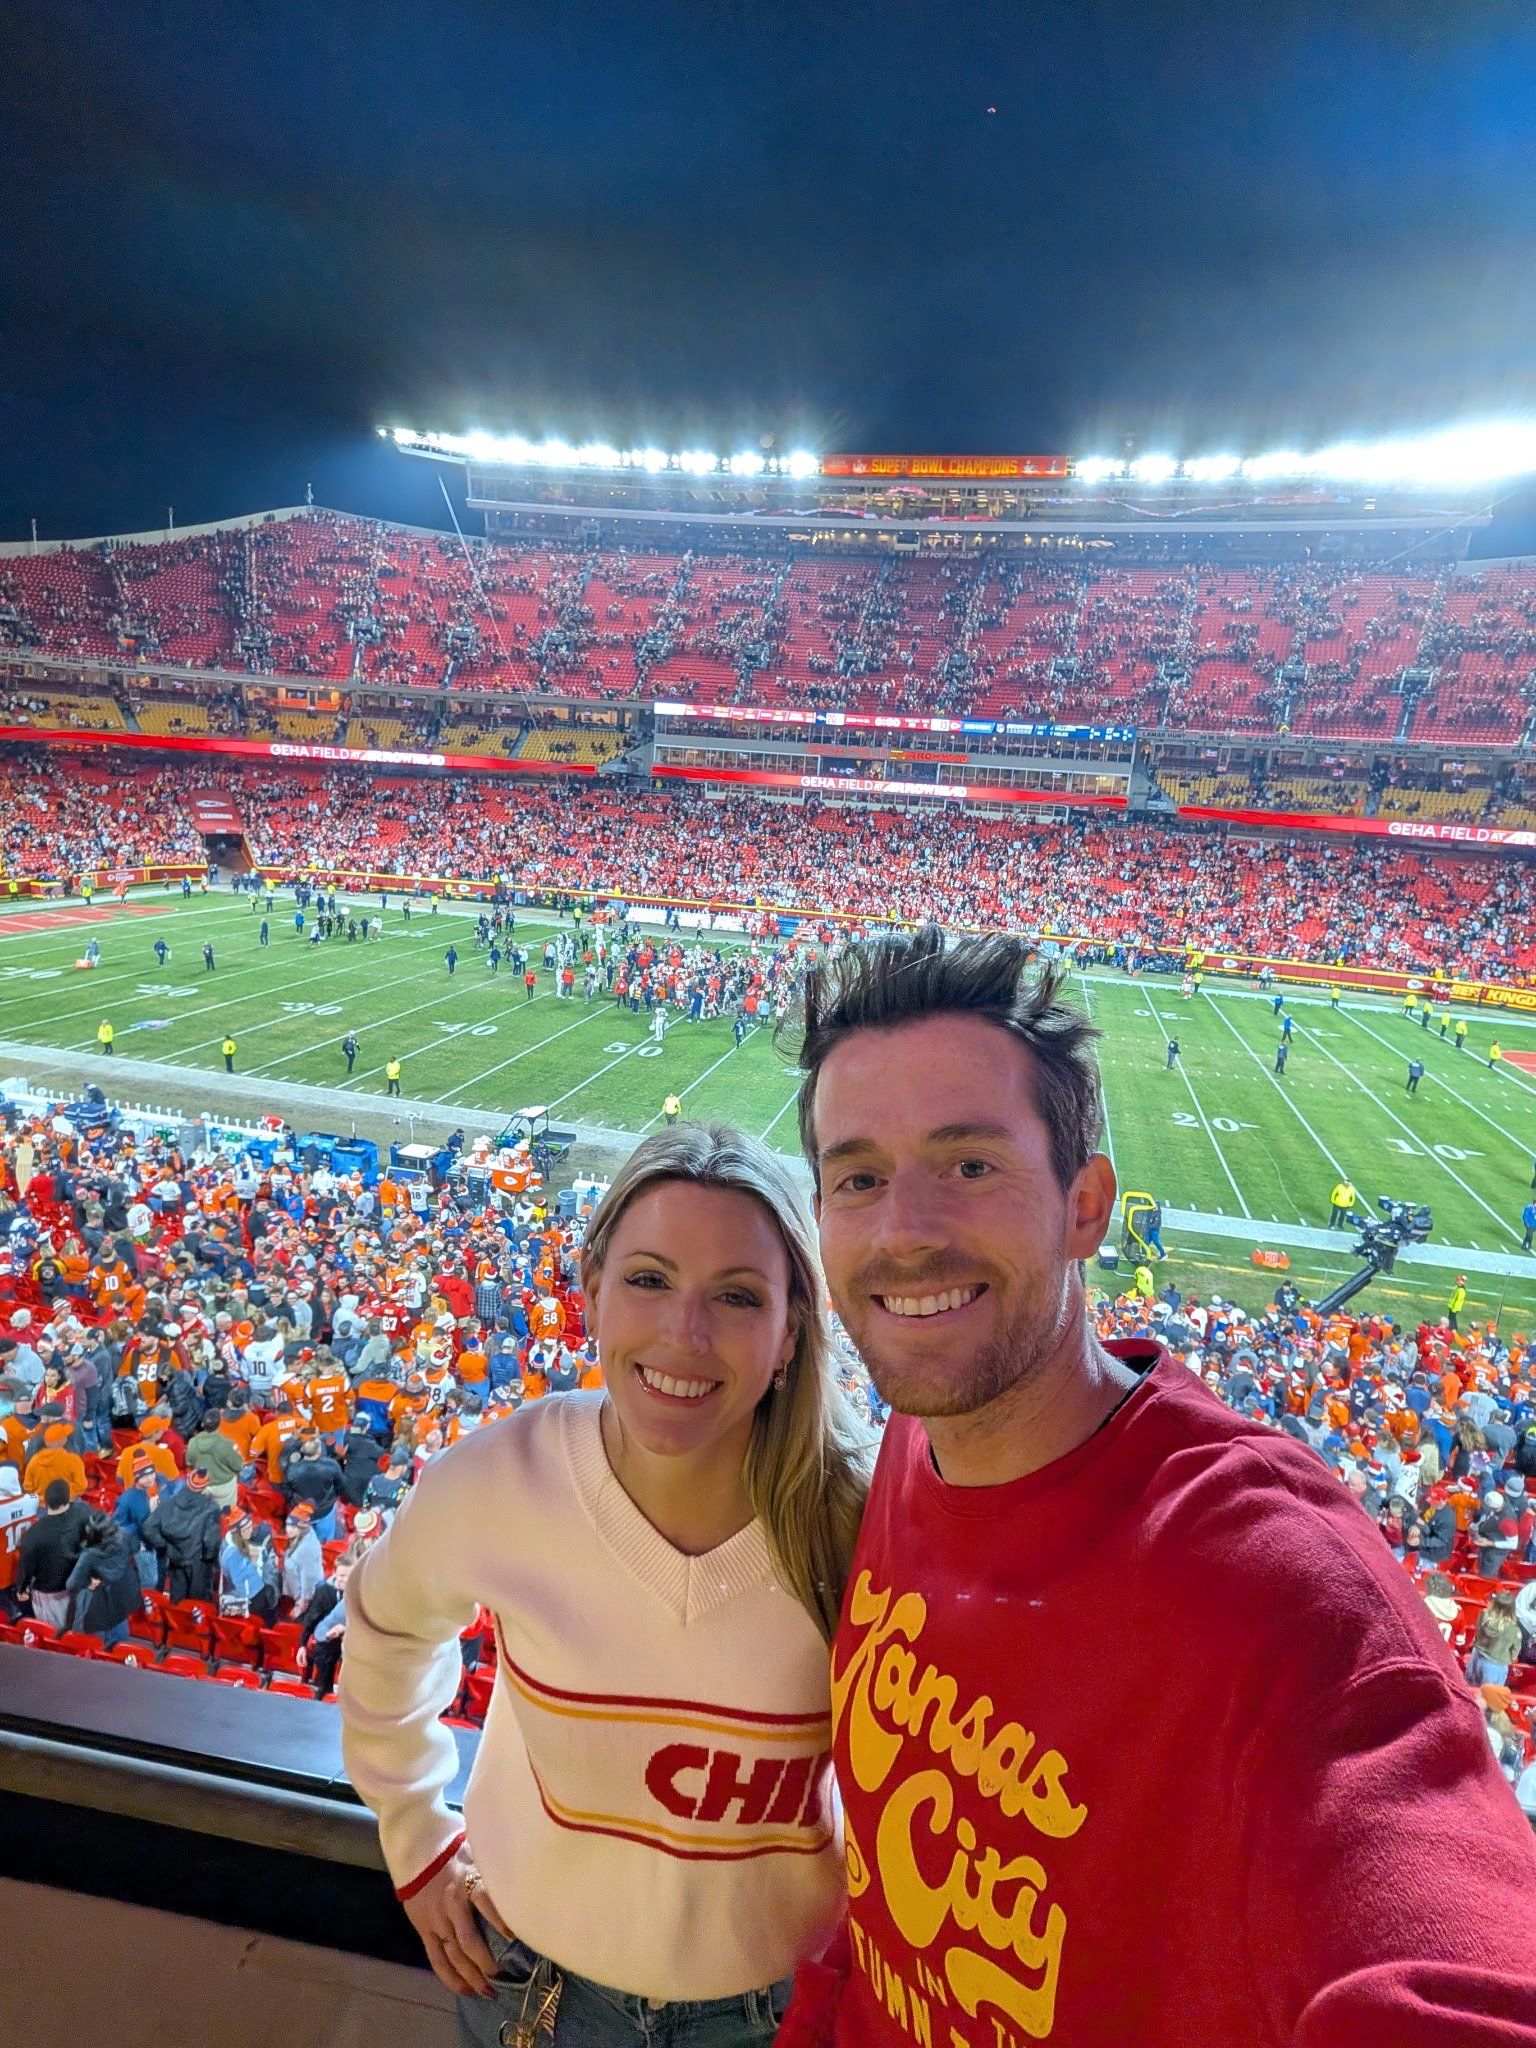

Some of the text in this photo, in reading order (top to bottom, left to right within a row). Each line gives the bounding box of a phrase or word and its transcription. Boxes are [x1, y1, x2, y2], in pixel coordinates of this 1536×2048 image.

[871, 458, 908, 473] SUPER
[911, 459, 945, 474] BOWL
[948, 459, 1018, 475] CHAMPIONS
[269, 743, 310, 758] GEHA
[312, 746, 350, 760] FIELD
[800, 776, 836, 789] GEHA
[838, 778, 873, 791] FIELD
[873, 783, 885, 792] AT
[1388, 821, 1436, 838] GEHA
[1440, 825, 1490, 842] FIELD
[1490, 832, 1506, 842] AT
[602, 1041, 664, 1058] 50
[1171, 1111, 1241, 1133] 20
[1386, 1138, 1468, 1161] 10
[205, 1191, 213, 1204] 2
[411, 1191, 422, 1201] 18
[104, 1275, 119, 1291] 10
[382, 1315, 398, 1332] 87
[542, 1308, 558, 1326] 58
[137, 1363, 157, 1382] 58
[252, 1360, 267, 1377] 10
[321, 1394, 335, 1413] 2
[1354, 1391, 1365, 1407] 2
[11, 1508, 24, 1520] NIX
[830, 1569, 1088, 1838] Kansas
[876, 1769, 1067, 2039] City
